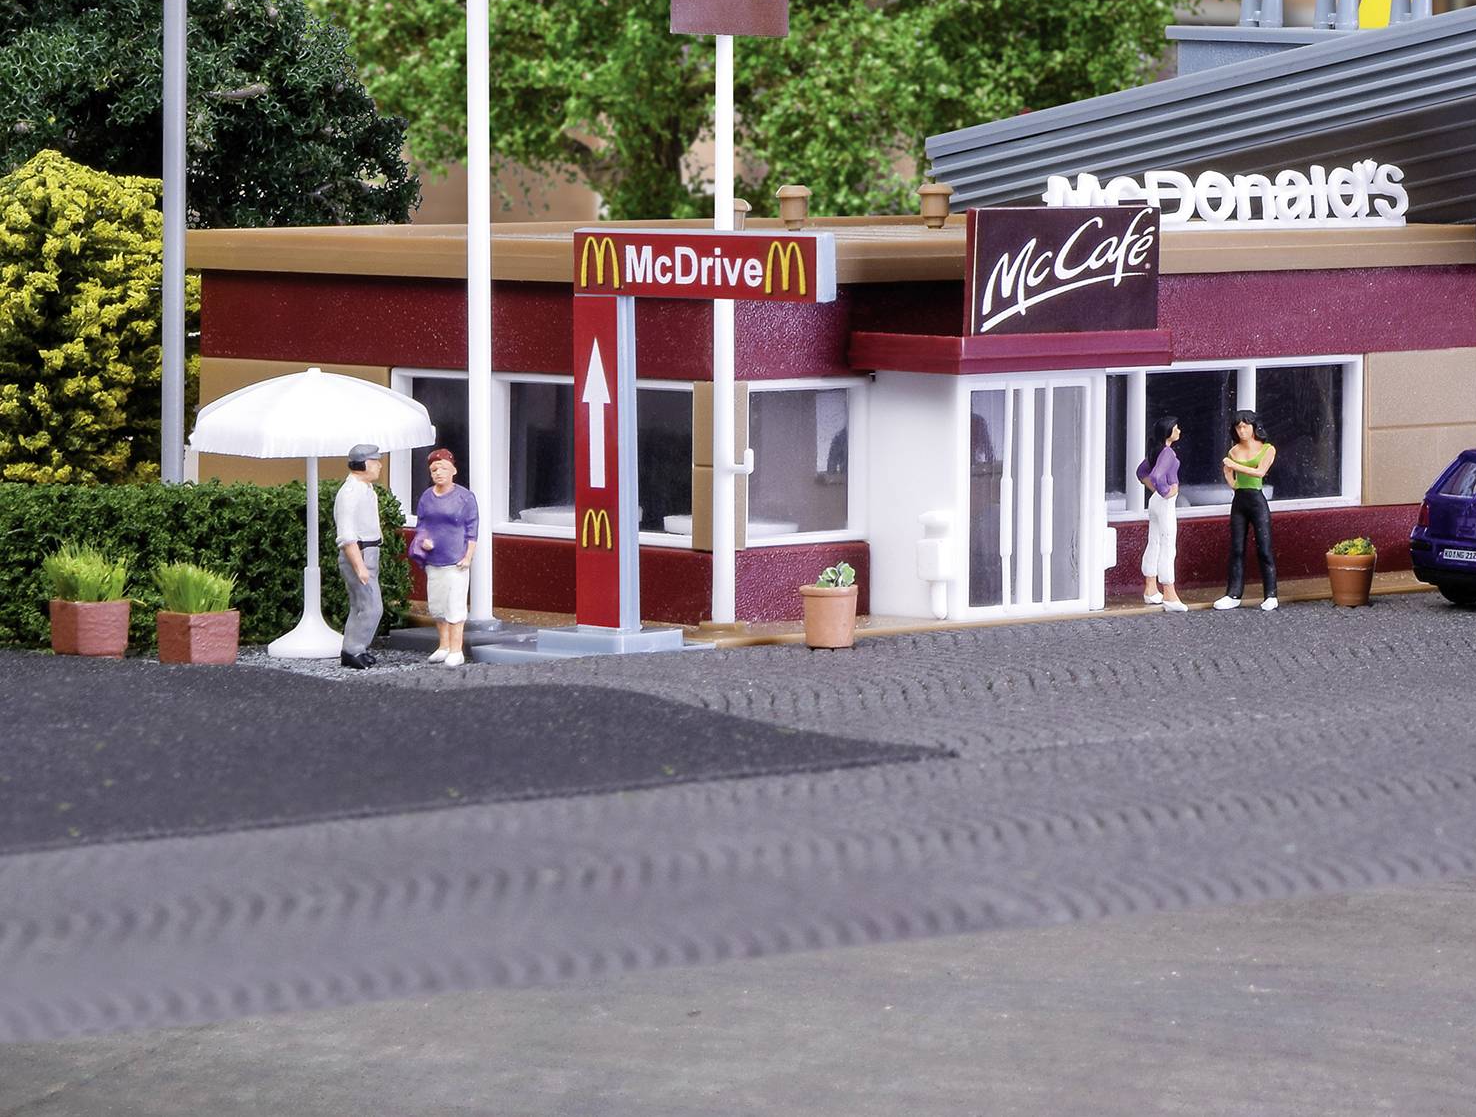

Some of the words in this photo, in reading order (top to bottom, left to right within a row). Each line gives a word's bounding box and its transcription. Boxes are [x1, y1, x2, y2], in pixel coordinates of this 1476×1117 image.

[1046, 158, 1410, 223] McDonald's
[624, 244, 763, 288] McDrive
[981, 207, 1156, 330] McCafé
